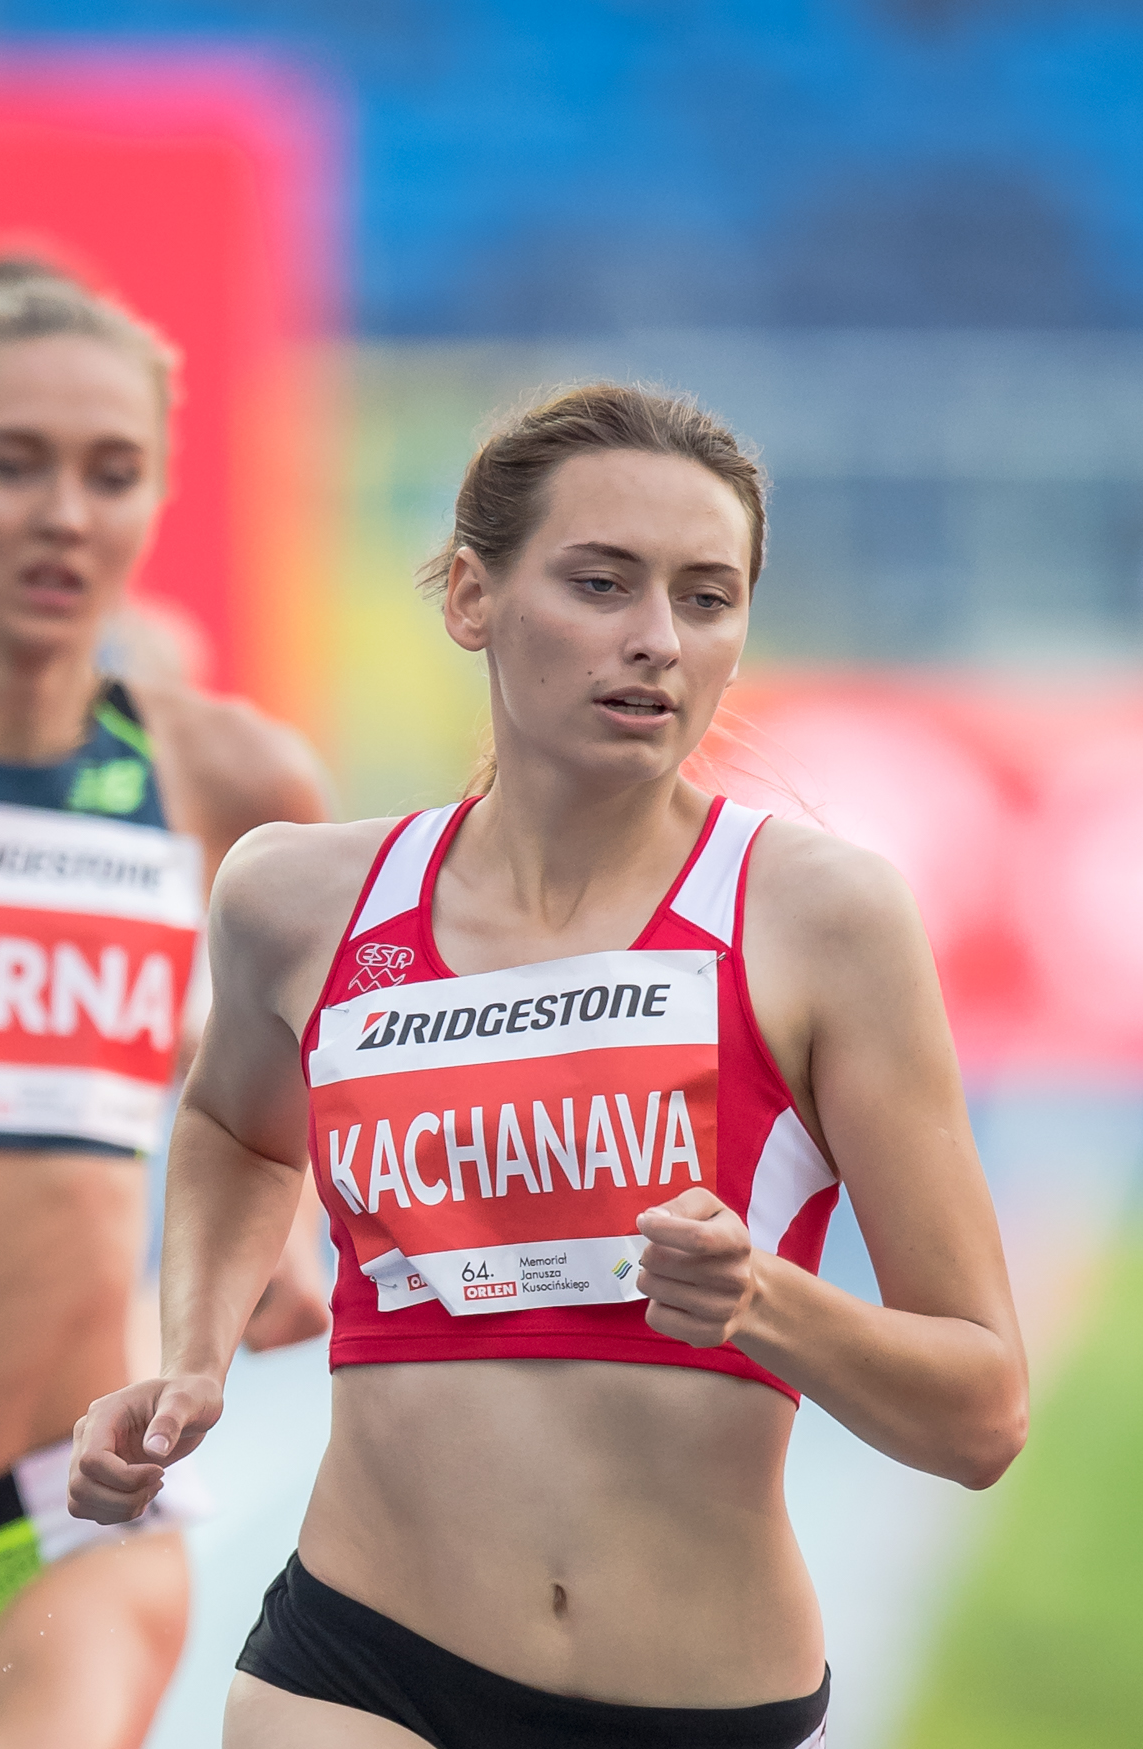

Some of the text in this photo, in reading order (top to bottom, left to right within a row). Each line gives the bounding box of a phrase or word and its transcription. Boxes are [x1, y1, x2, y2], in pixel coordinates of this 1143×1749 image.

[356, 984, 670, 1050] BRIDGESTONE
[329, 1091, 702, 1215] KACHANAVA
[519, 1252, 567, 1268] Memoriał
[462, 1260, 494, 1282] 64.
[520, 1269, 562, 1281] Janusza
[466, 1284, 515, 1299] ORLEN
[522, 1279, 590, 1294] Kusocińskiego
